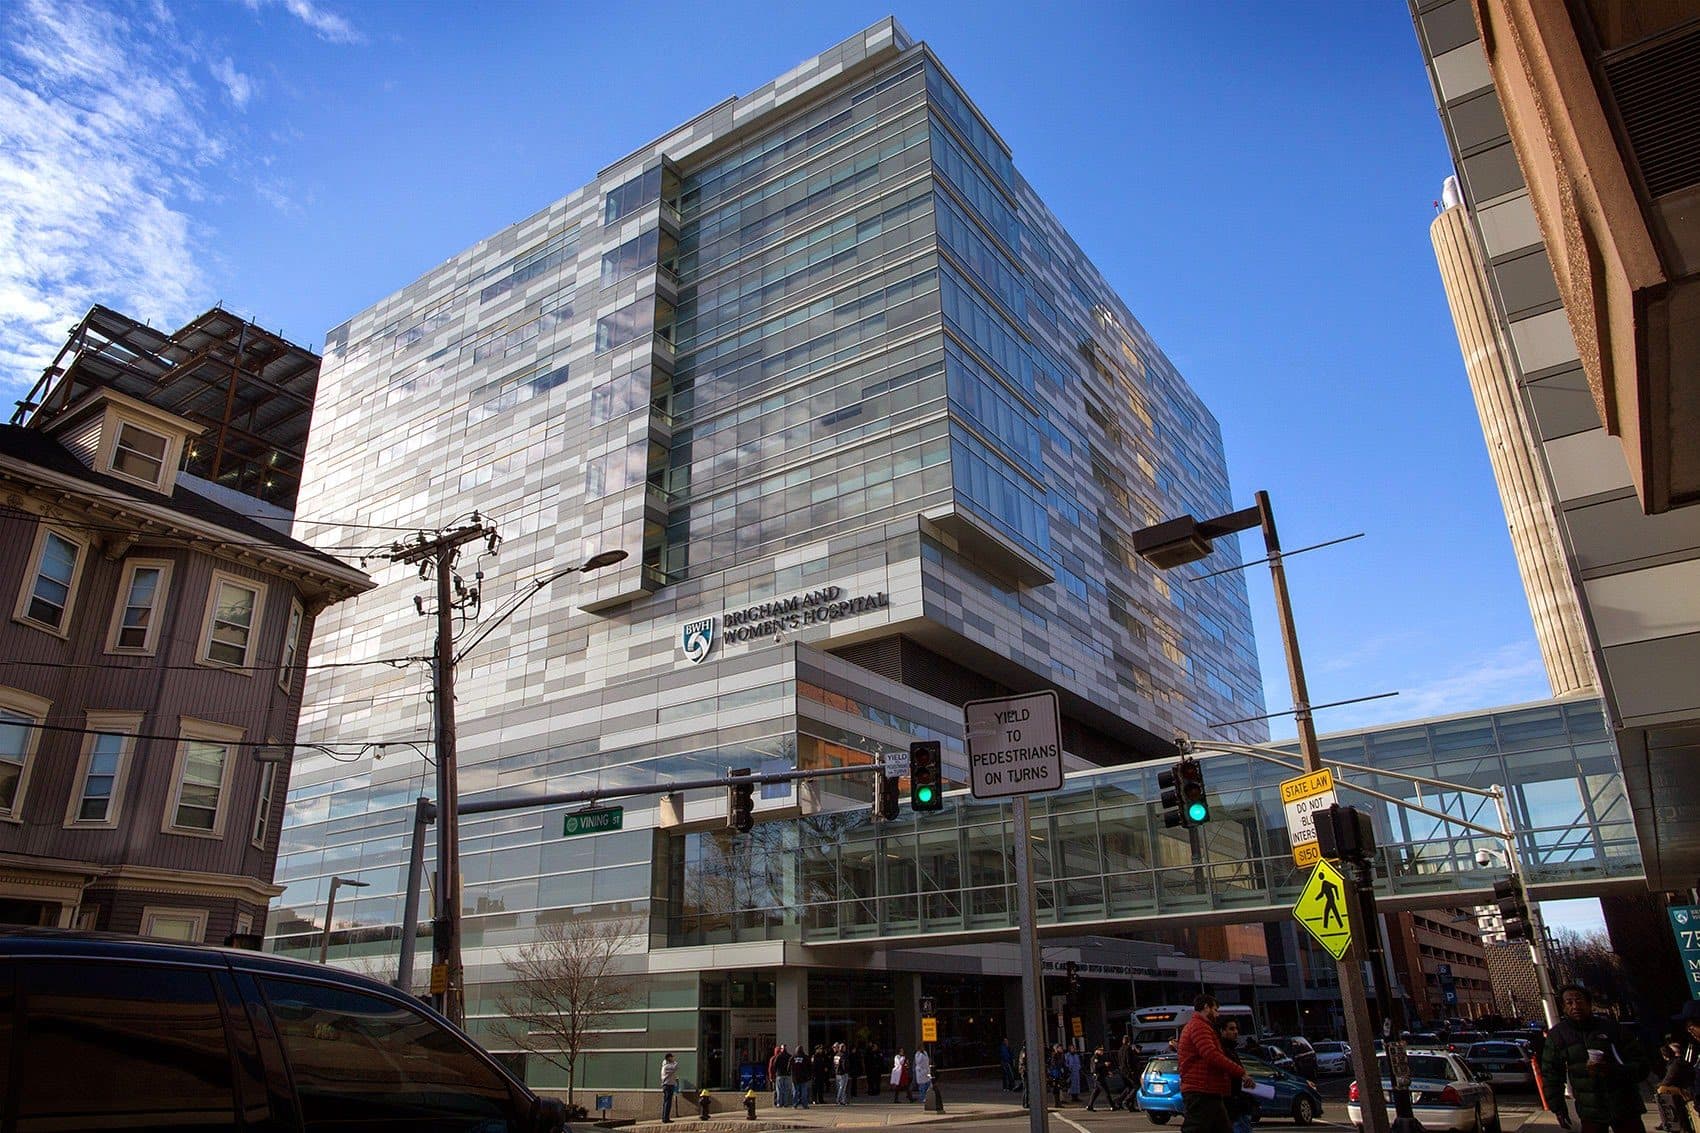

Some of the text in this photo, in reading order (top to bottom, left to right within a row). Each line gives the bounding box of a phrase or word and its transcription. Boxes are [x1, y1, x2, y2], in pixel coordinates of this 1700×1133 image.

[724, 585, 841, 628] BRIGHAM AND
[724, 592, 889, 644] WOMEN'S HOSPITAL
[686, 619, 710, 635] BWH
[994, 708, 1030, 725] YIELD
[1006, 729, 1022, 743] TO
[887, 753, 907, 761] YIELD
[973, 744, 1057, 767] PEDESTRIANS
[984, 766, 1048, 786] ON TURNS
[1285, 775, 1328, 798] STATE LAW
[1296, 797, 1323, 814] DO NOT
[580, 814, 609, 829] VINING
[1301, 815, 1315, 827] BLO
